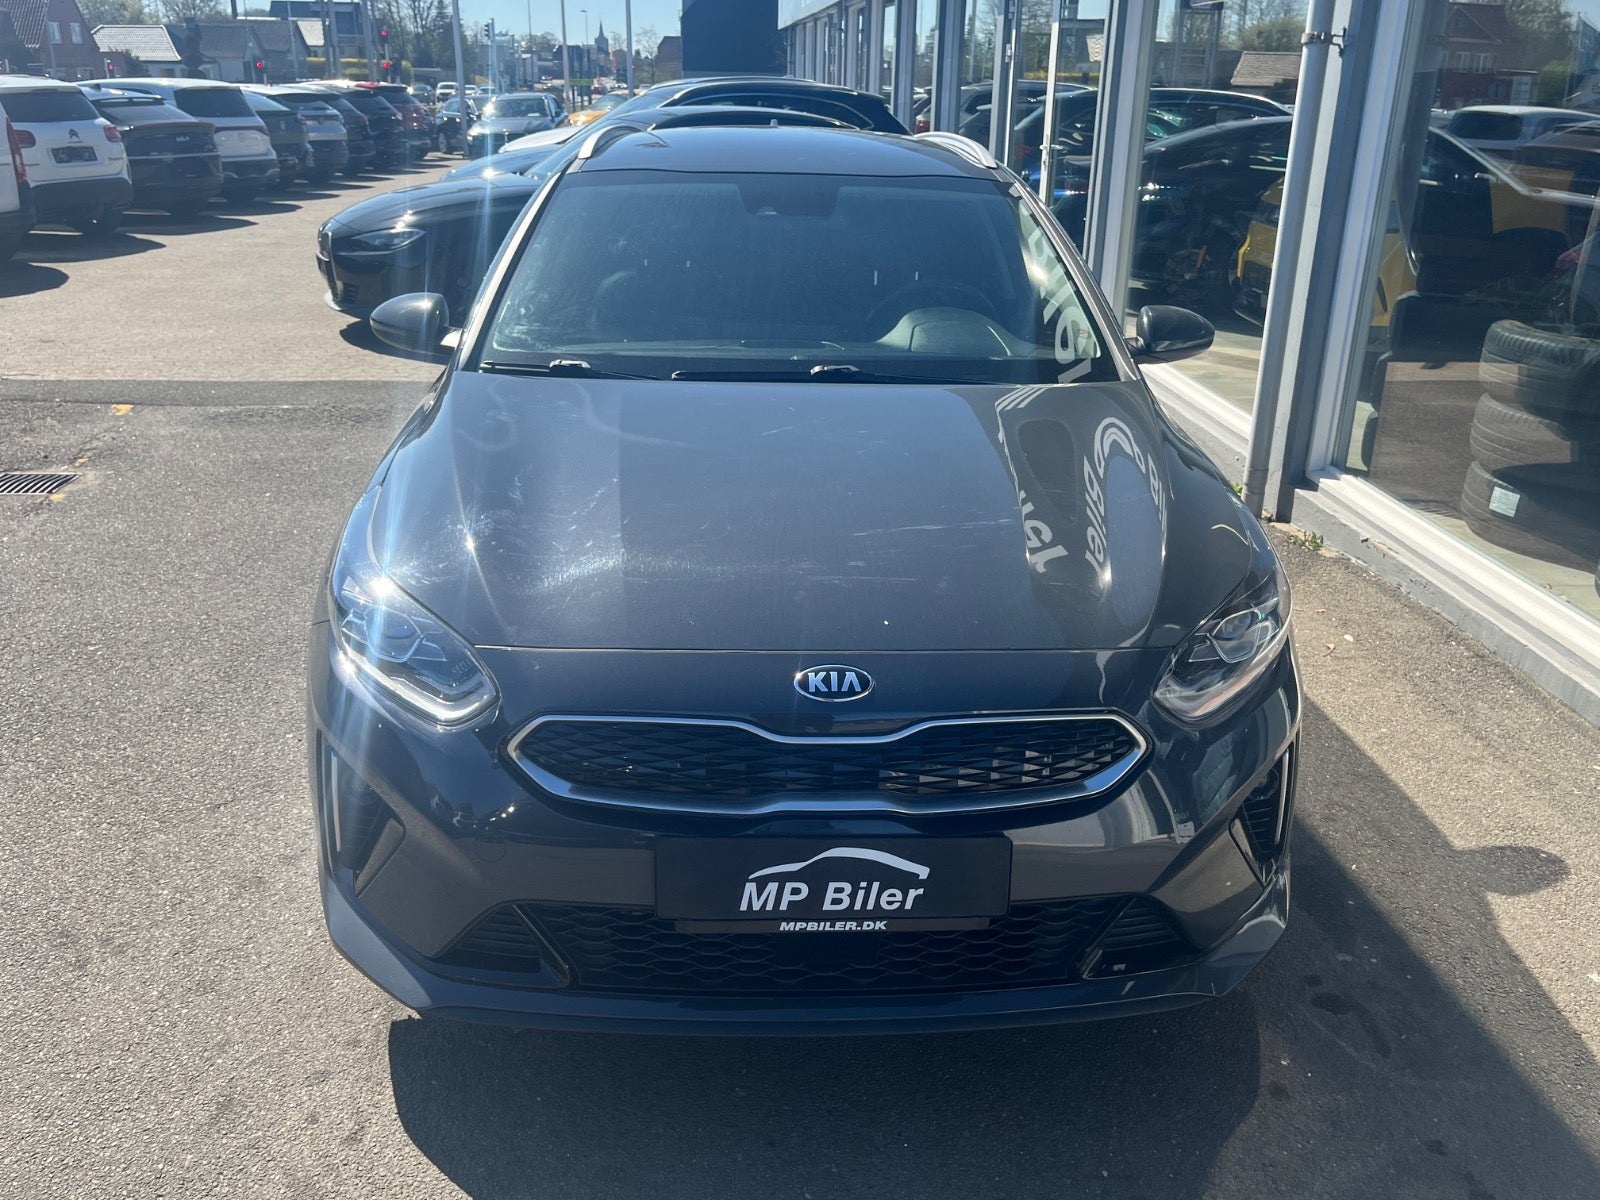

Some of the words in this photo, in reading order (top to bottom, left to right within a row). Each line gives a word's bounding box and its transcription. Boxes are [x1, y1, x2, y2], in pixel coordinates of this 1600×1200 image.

[807, 671, 862, 692] KIA
[739, 881, 809, 911] MP
[822, 881, 924, 911] Biler
[779, 920, 888, 931] MPBILER.DK
